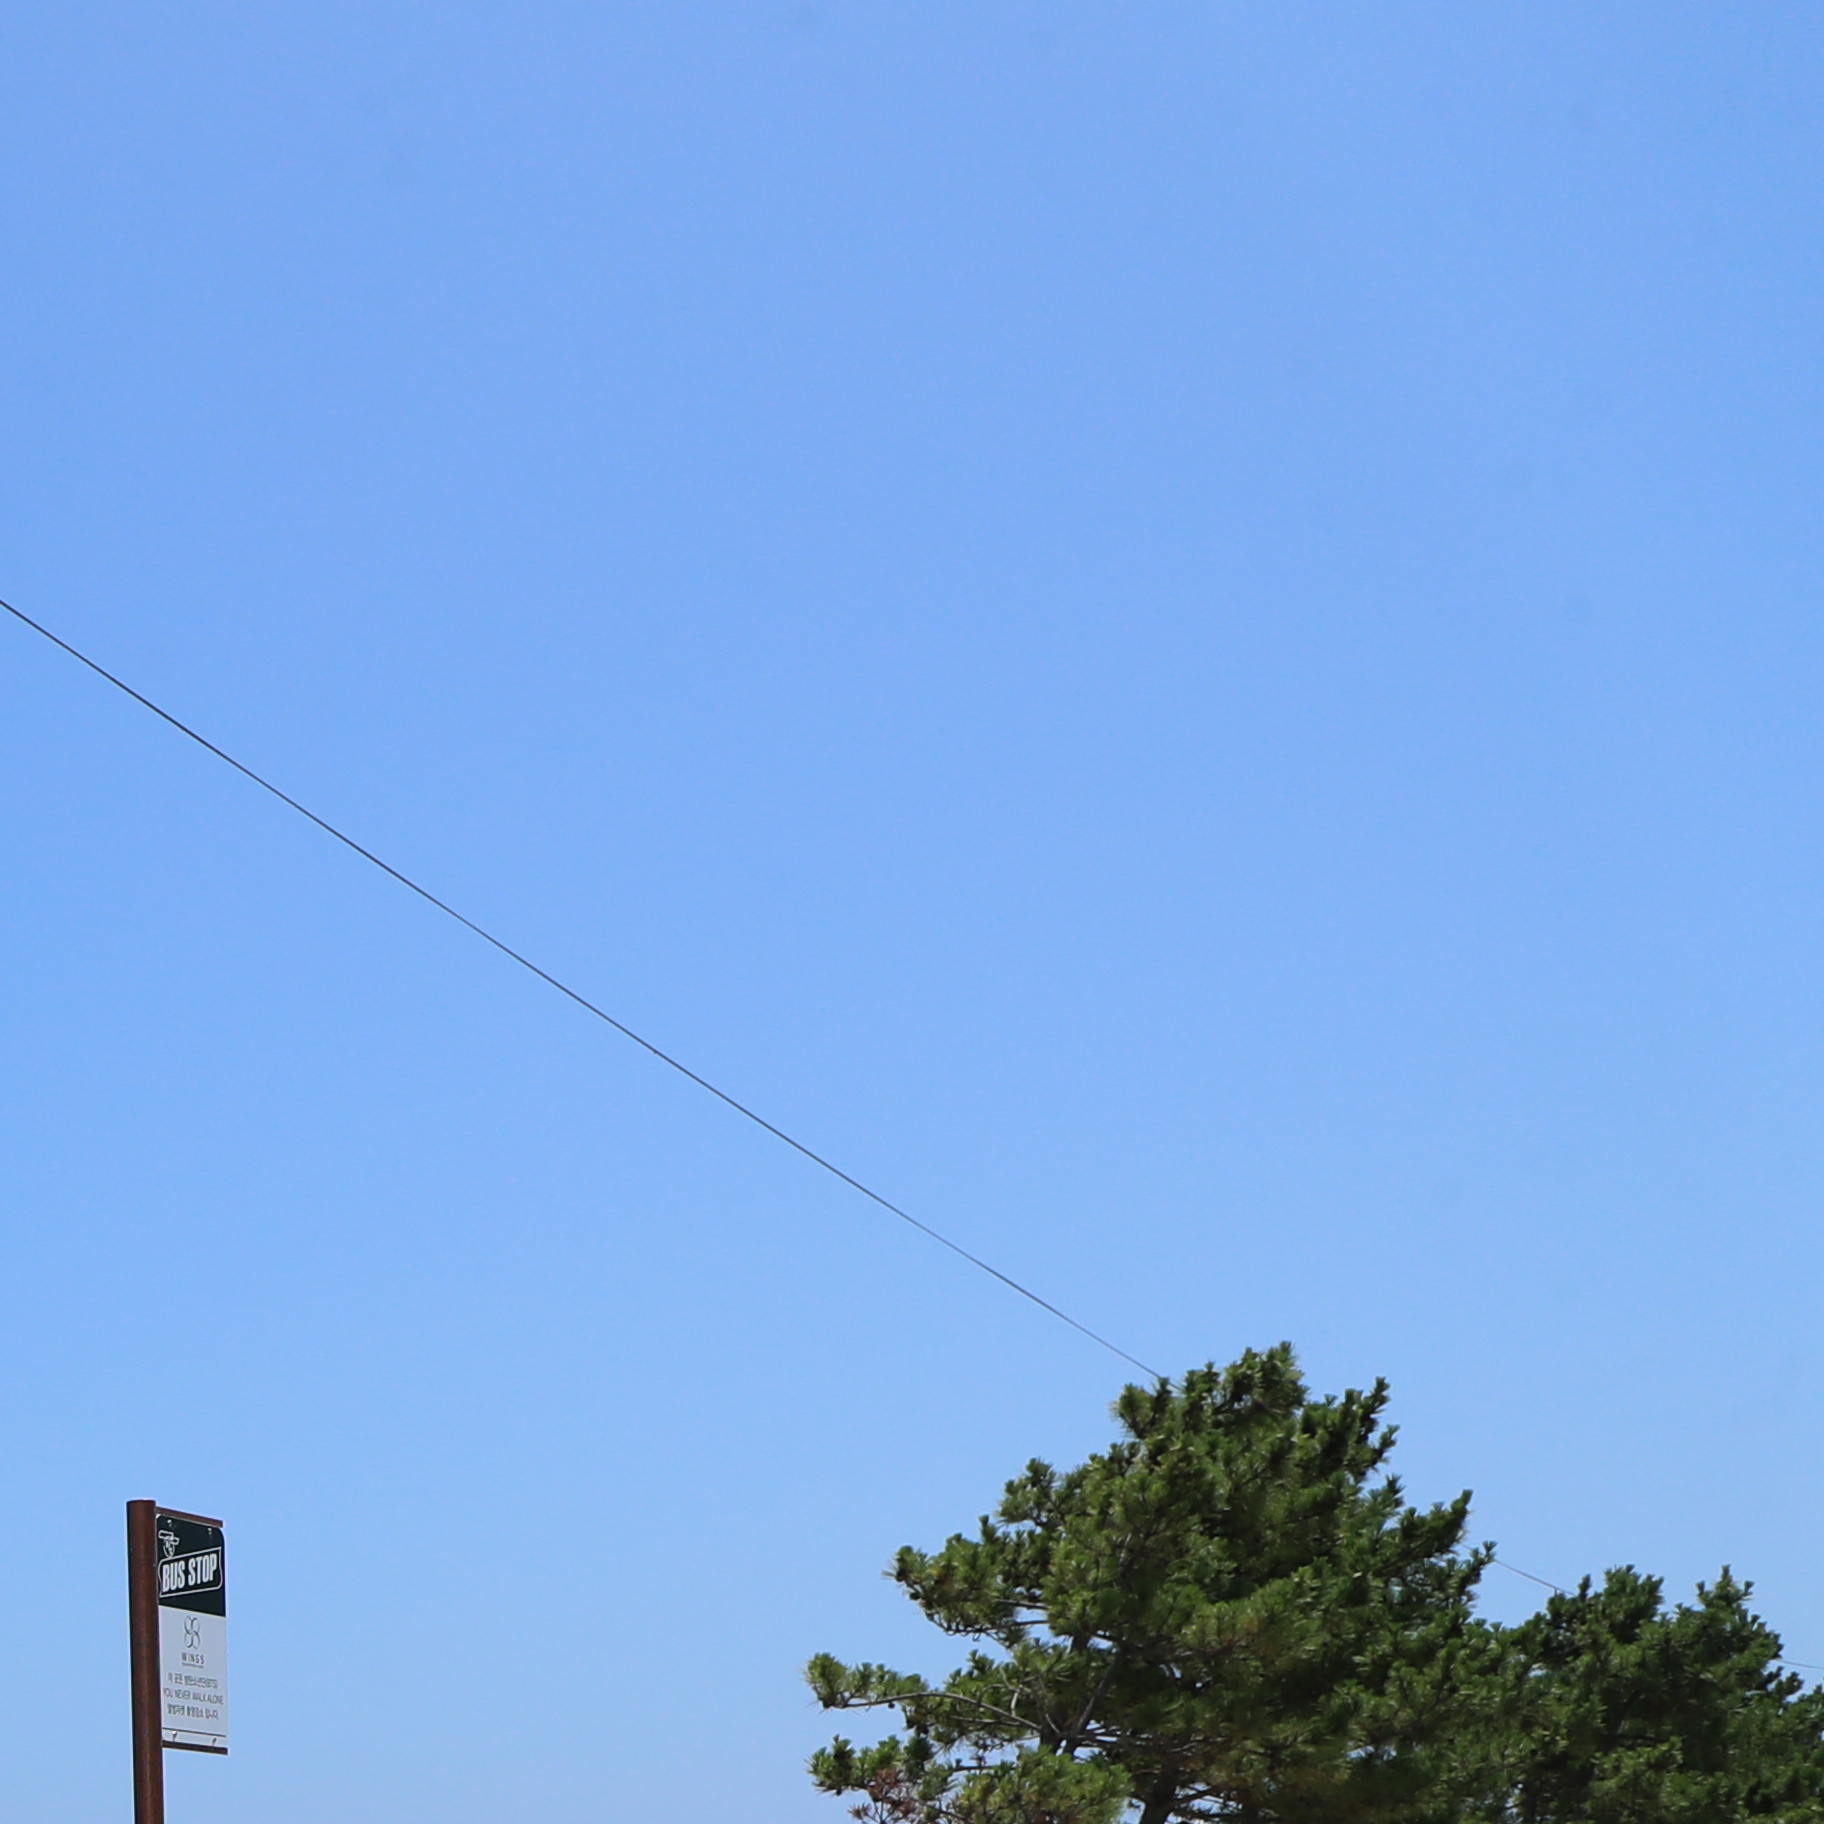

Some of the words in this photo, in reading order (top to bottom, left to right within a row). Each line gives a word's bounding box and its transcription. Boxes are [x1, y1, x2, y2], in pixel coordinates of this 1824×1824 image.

[162, 1560, 185, 1592] BUS
[188, 1553, 217, 1586] STOP
[181, 1652, 205, 1665] WINGS
[163, 1687, 173, 1698] YOU
[174, 1689, 191, 1700] NEVER
